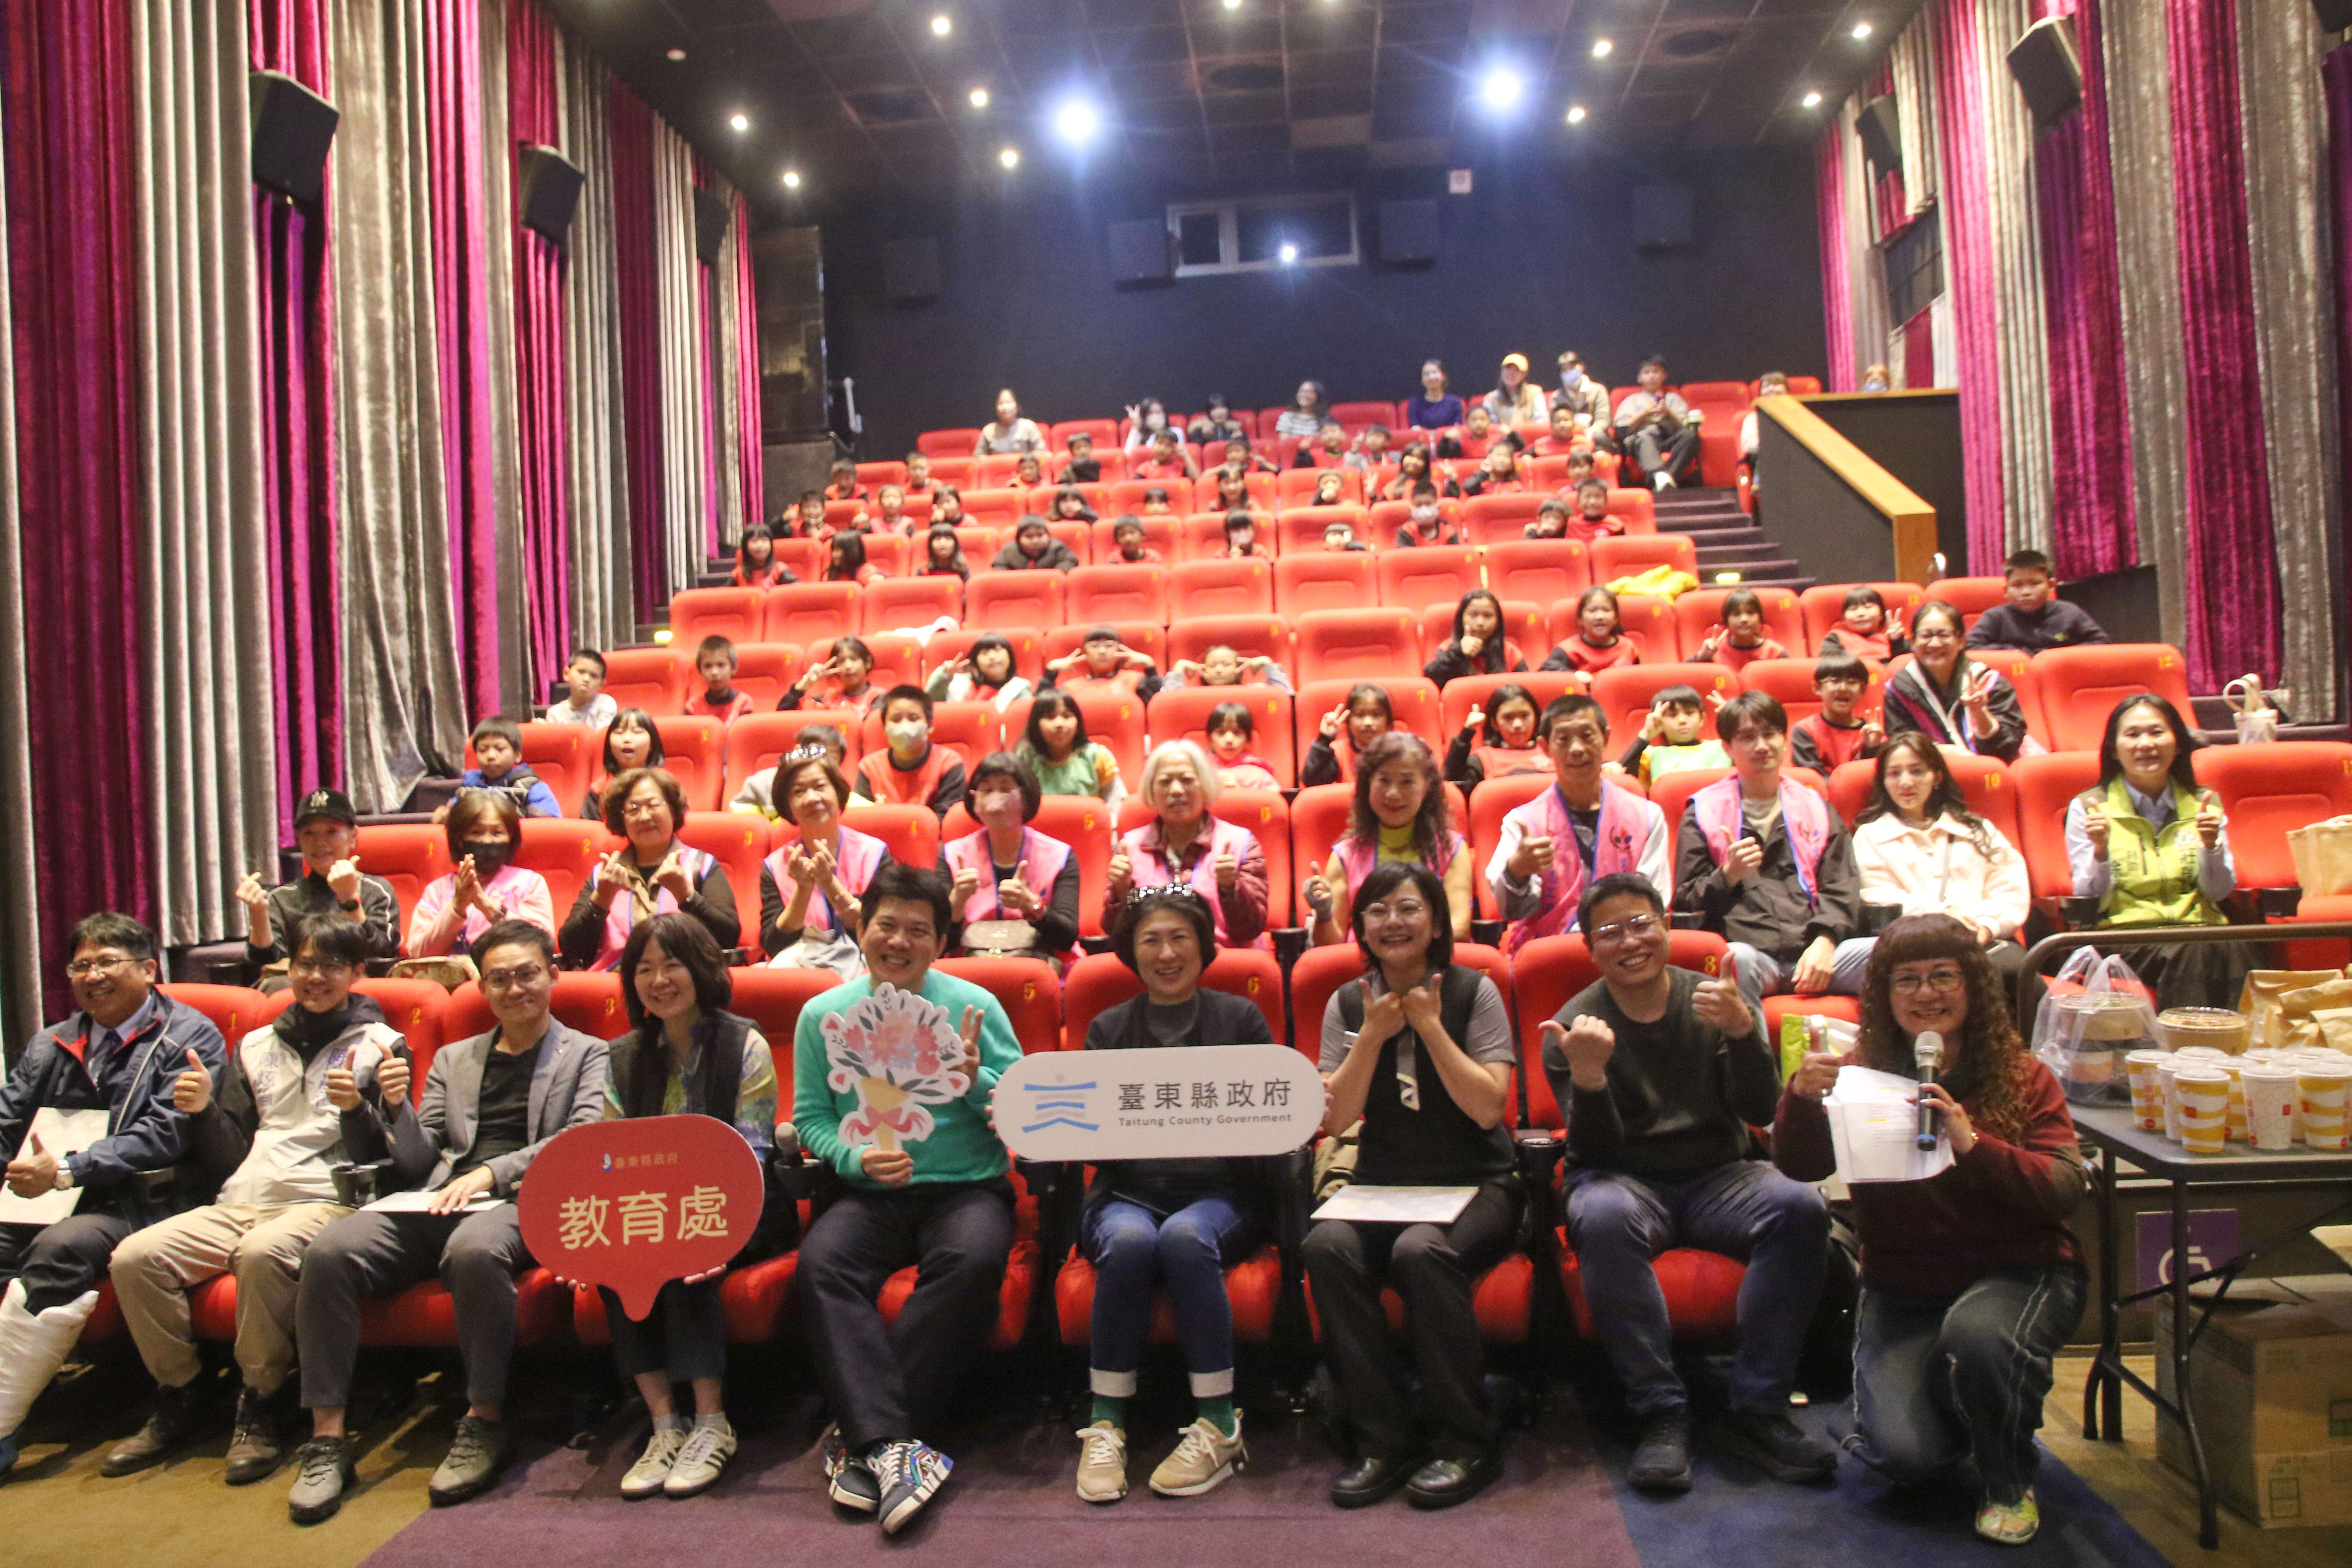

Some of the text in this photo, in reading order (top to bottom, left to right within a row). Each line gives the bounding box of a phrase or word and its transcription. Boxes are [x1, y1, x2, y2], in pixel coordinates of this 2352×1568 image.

[1983, 772, 2001, 789] 10
[1084, 813, 1095, 830] 5
[1260, 805, 1271, 822] 6
[582, 838, 591, 853] 2
[744, 830, 753, 846] 3
[429, 841, 433, 856] 1
[1704, 955, 1716, 974] 8
[1024, 982, 1035, 1000] 5
[1247, 976, 1259, 994] 6
[605, 997, 616, 1015] 3
[230, 1012, 237, 1030] 1
[412, 1007, 421, 1024] 2
[1118, 1078, 1291, 1111] 臺東縣政府
[1118, 1113, 1292, 1127] Taitung County Government
[559, 1185, 729, 1250] 教育處
